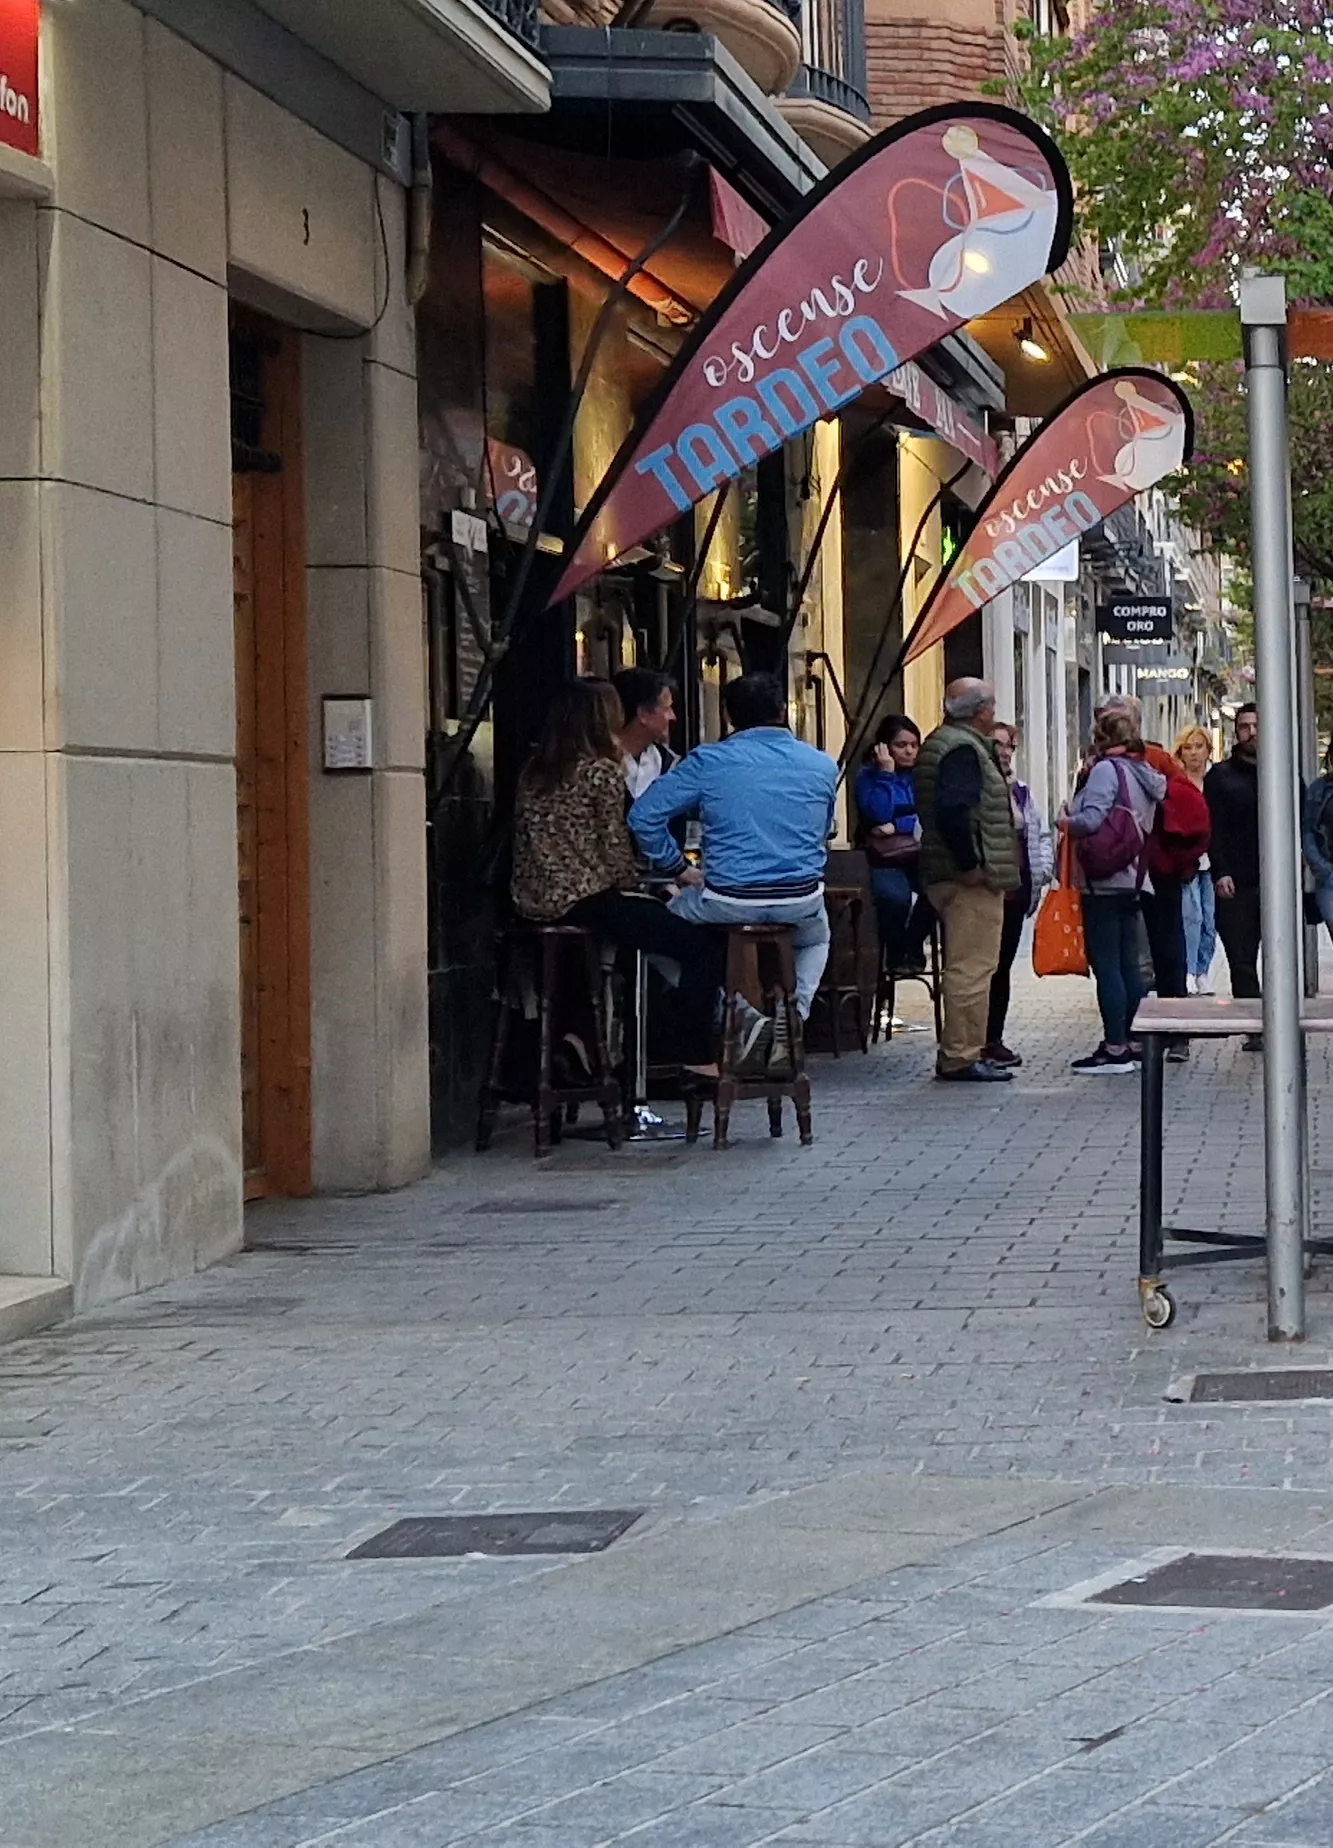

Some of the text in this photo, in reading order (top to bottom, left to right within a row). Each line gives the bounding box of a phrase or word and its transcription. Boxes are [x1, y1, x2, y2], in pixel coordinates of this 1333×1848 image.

[703, 257, 884, 387] oscense
[634, 315, 899, 512] TARDEO
[983, 456, 1088, 538] oscense
[952, 491, 1104, 609] TARDEO
[1112, 604, 1167, 618] COMPRO
[1126, 620, 1154, 632] ORO
[1136, 667, 1190, 680] MANGO
